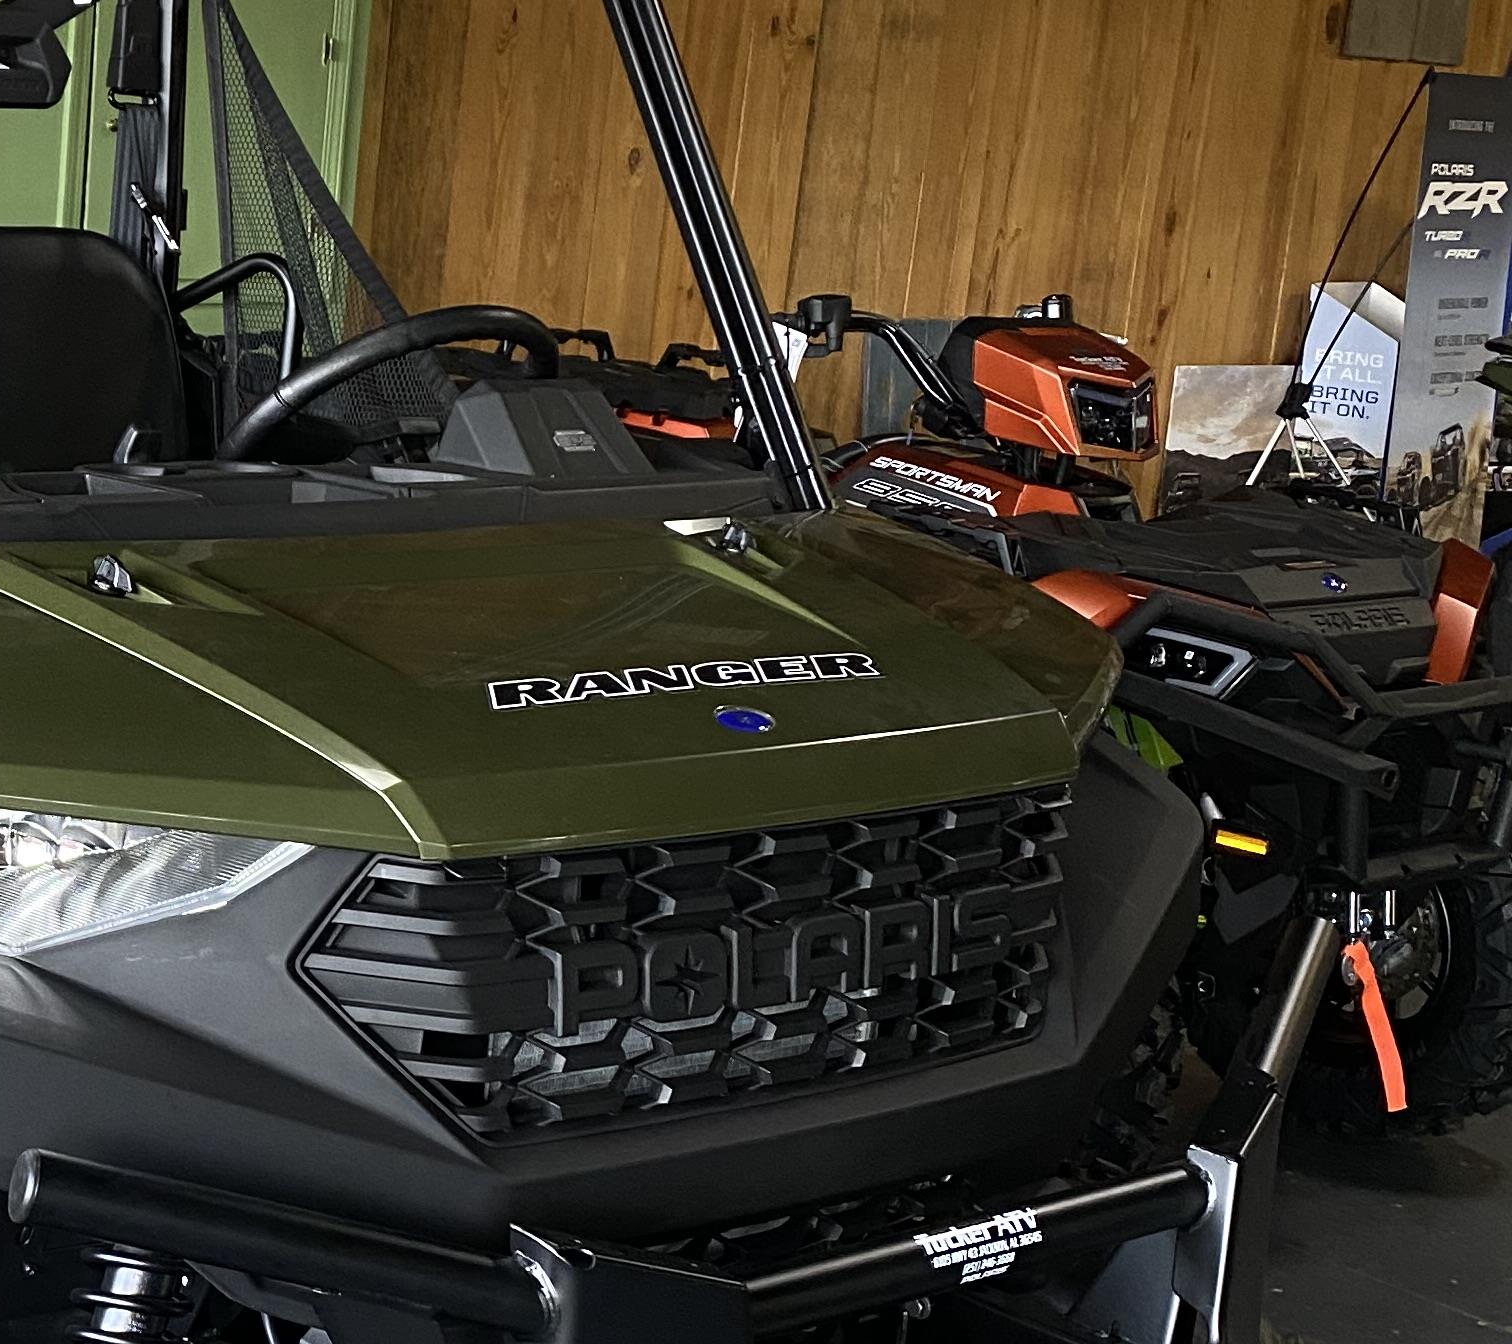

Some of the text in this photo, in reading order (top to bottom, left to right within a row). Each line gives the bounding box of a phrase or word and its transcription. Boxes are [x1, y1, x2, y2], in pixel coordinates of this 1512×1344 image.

[1430, 162, 1475, 177] POLARIS
[1416, 180, 1509, 220] RZR
[1314, 348, 1385, 369] BRING
[1311, 384, 1380, 405] BRING
[1308, 400, 1370, 420] IT ON.
[869, 456, 1002, 502] SPORTSMAN
[488, 652, 884, 710] RANGER
[550, 887, 1013, 1038] POLARIS
